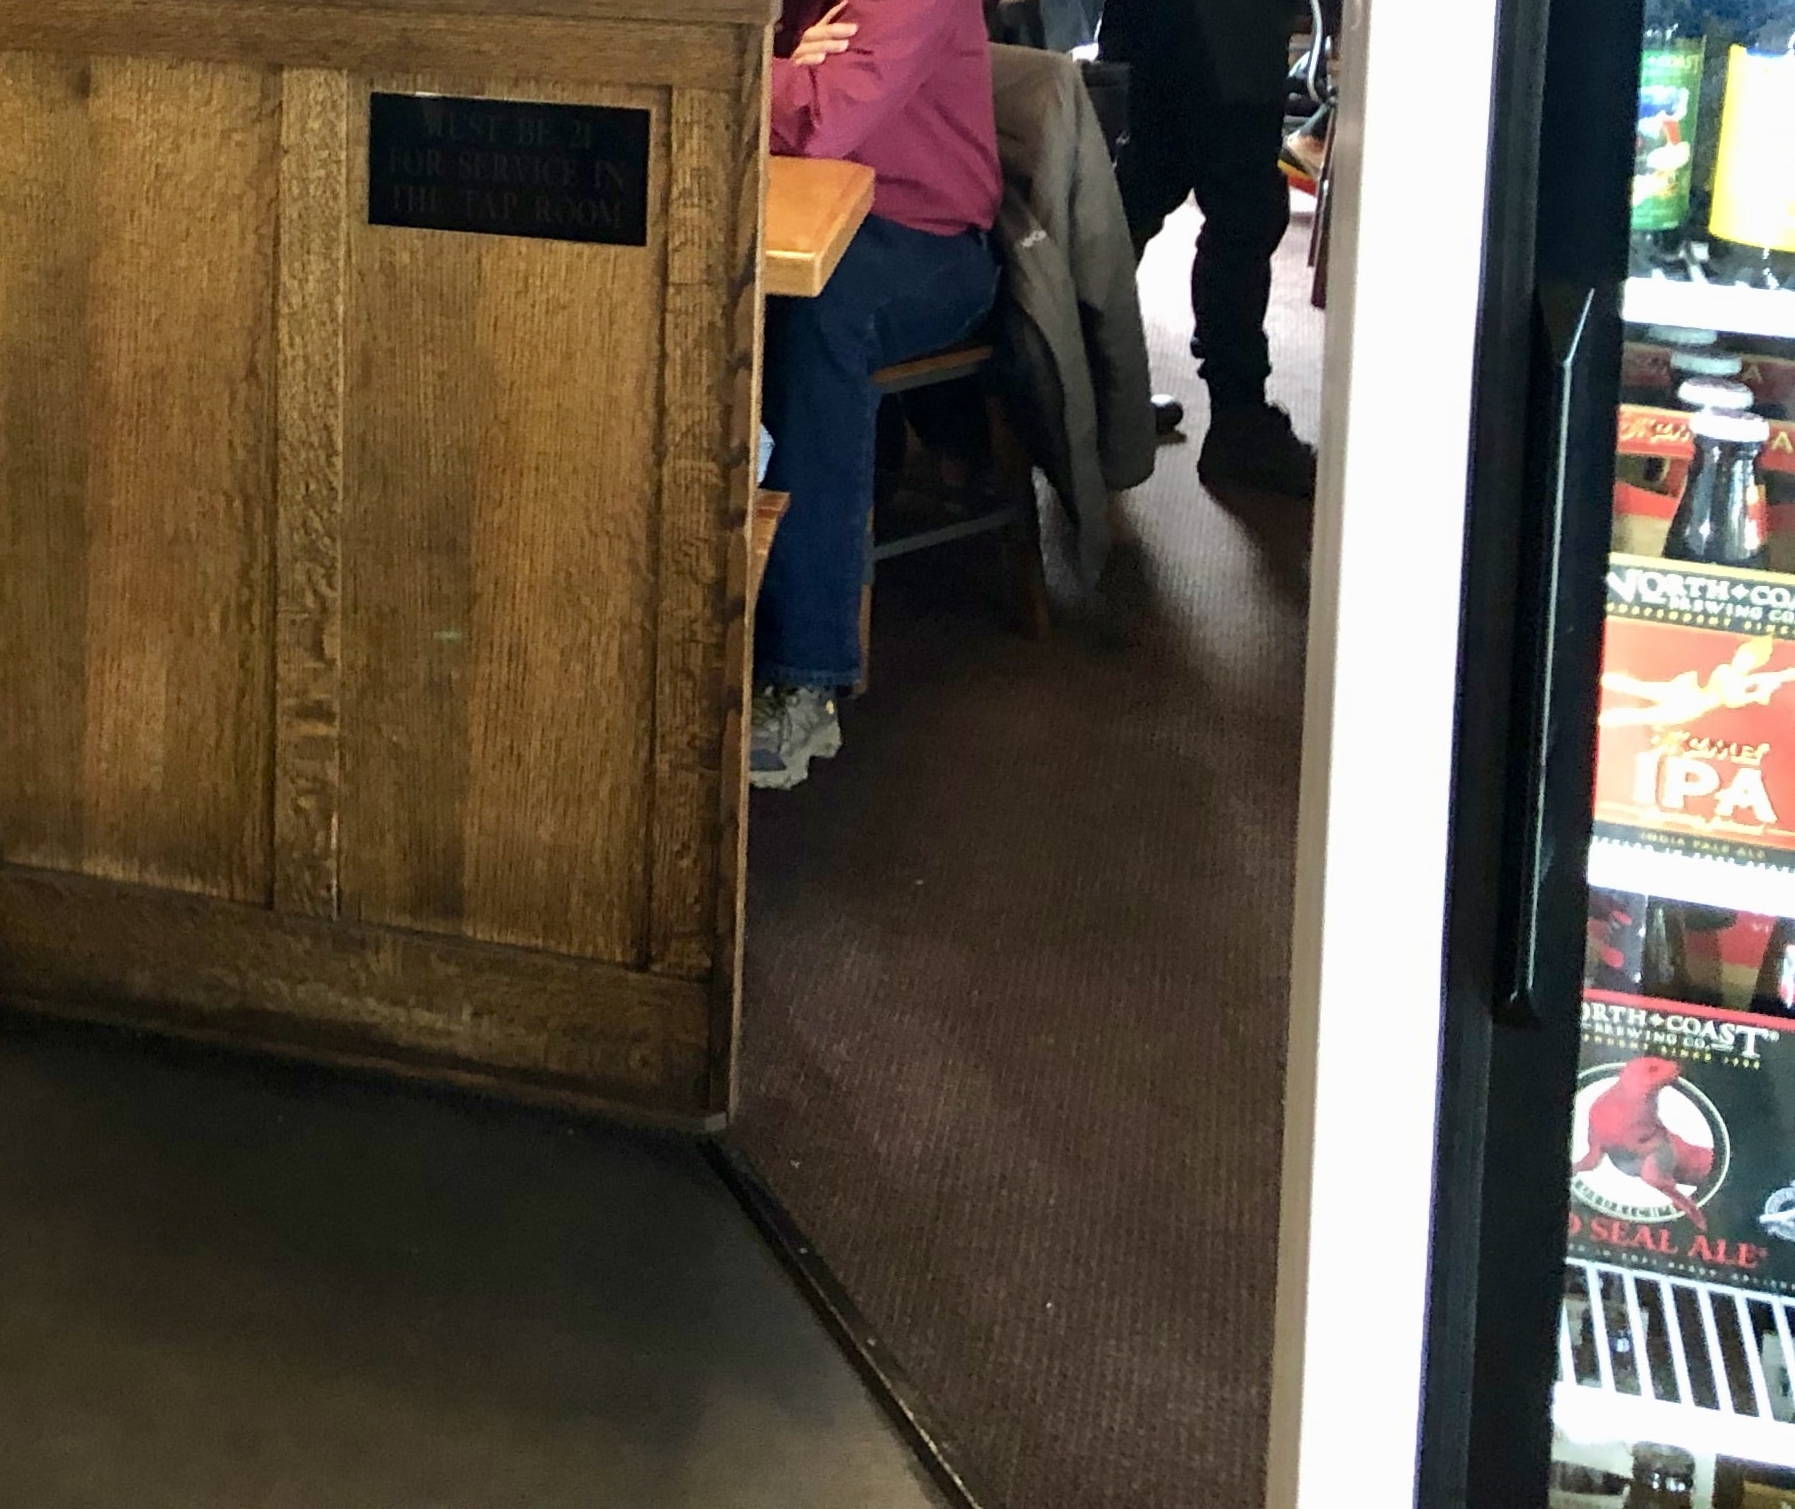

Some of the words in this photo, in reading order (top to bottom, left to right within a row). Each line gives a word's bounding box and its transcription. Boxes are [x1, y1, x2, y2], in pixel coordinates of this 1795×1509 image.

[389, 147, 441, 176] FOR
[458, 151, 578, 187] SERVICE
[393, 185, 443, 214] THE
[464, 190, 519, 221] TAP
[1607, 568, 1730, 604] NORTH
[1632, 751, 1778, 823] IPA
[1666, 1015, 1769, 1059] COAST
[1590, 1217, 1678, 1254] SEAL
[1688, 1235, 1758, 1268] ALE
